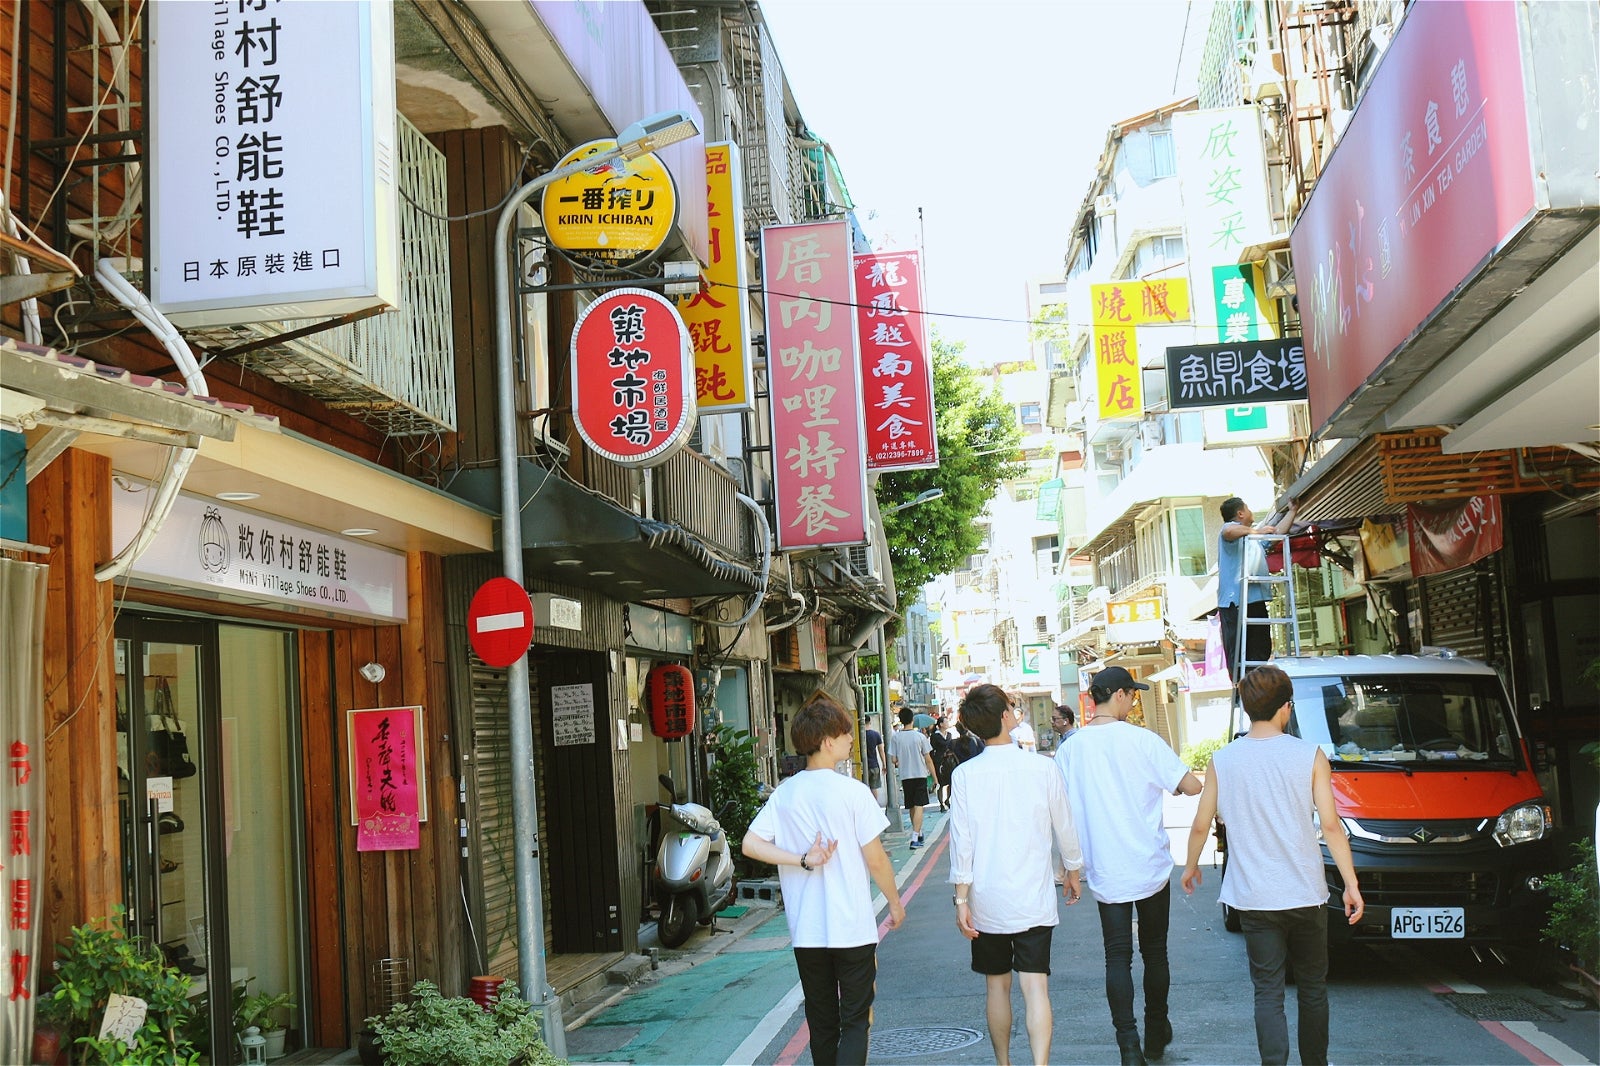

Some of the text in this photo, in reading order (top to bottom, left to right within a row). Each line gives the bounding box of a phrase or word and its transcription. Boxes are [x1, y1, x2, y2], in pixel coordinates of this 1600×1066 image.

[214, 72, 229, 124] Shoes
[1200, 119, 1246, 252] 欣姿采
[1423, 184, 1436, 213] XIN
[1437, 164, 1454, 195] TEA
[1456, 117, 1488, 174] GARDEN
[558, 213, 654, 226] KIRIN ICHIBAN
[183, 248, 341, 283] 日本原裝進口
[607, 303, 653, 447] 築地市場
[864, 259, 924, 440] 龍鳳越南美食
[262, 573, 294, 595] Village
[297, 580, 317, 598] Shoes
